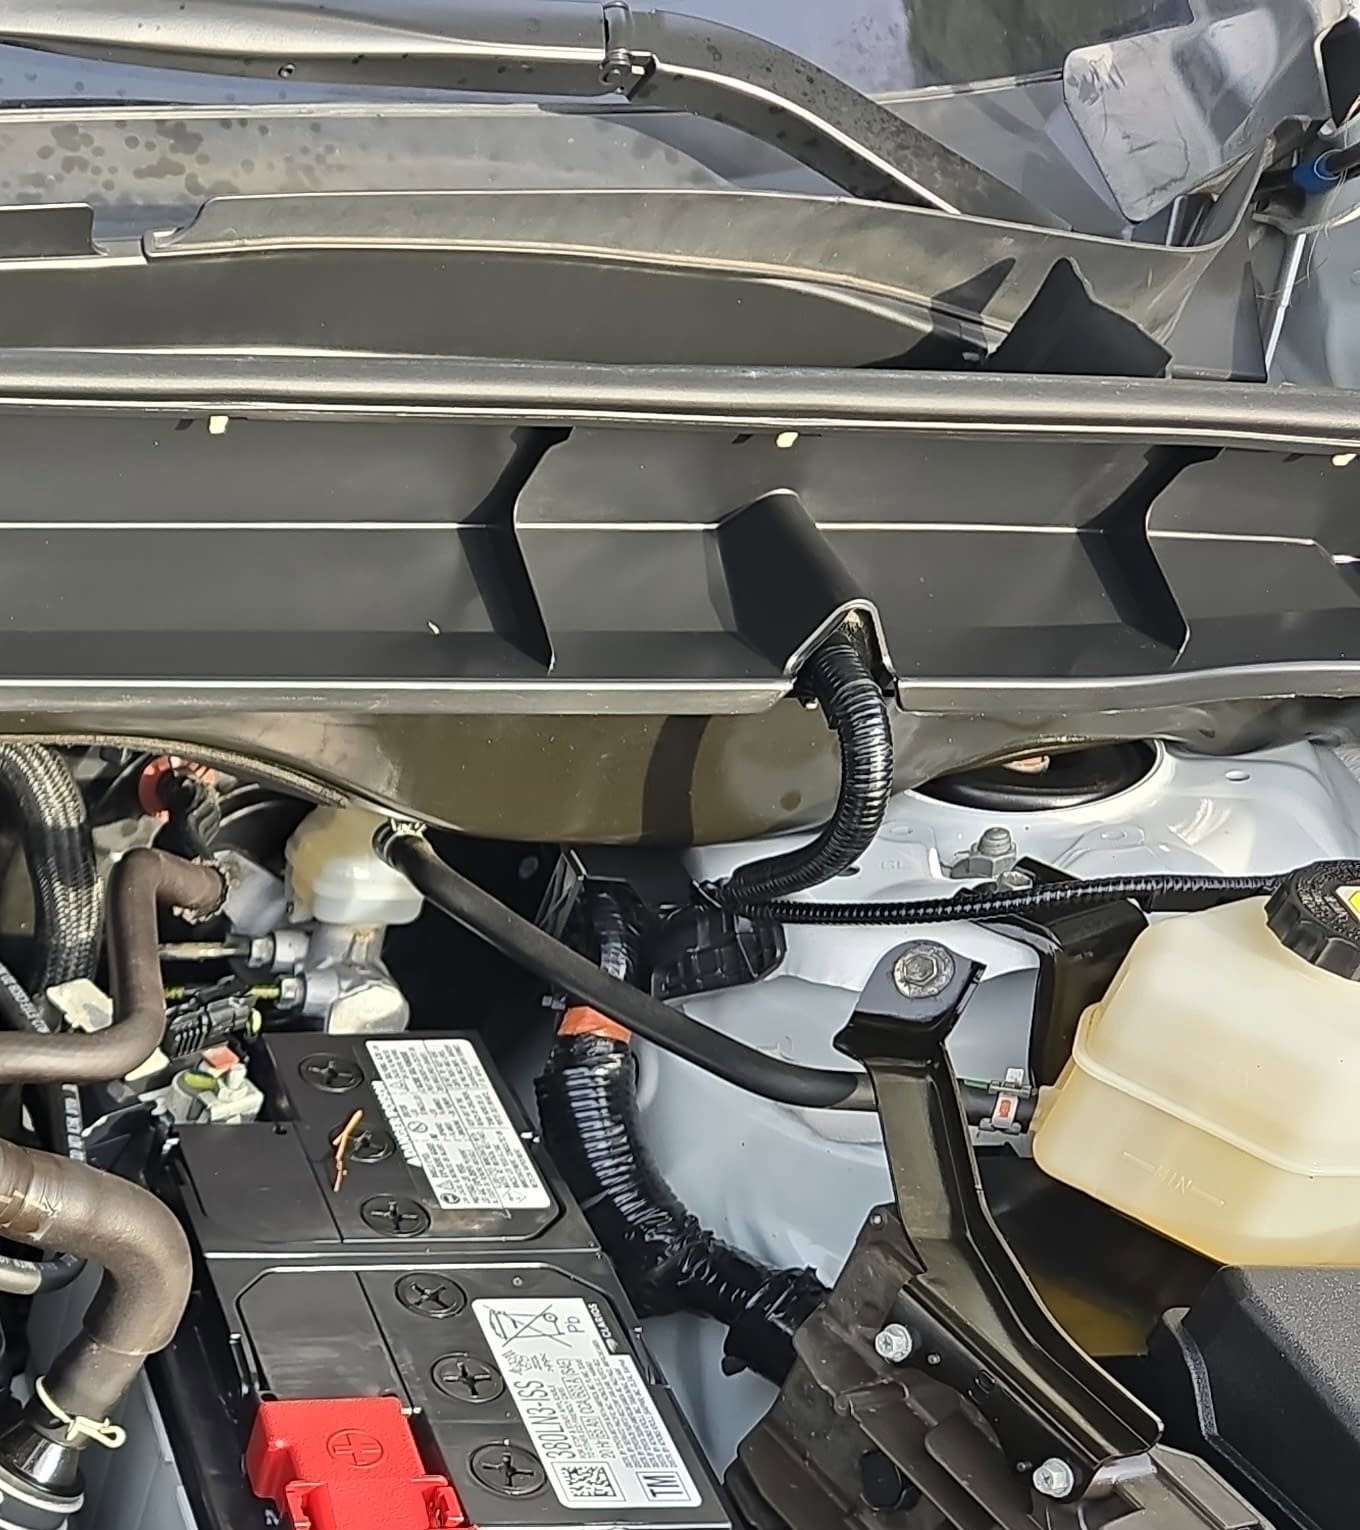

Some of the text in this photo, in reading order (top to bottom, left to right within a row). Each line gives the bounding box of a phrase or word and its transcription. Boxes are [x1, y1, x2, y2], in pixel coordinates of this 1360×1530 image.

[565, 1316, 584, 1333] Pb
[588, 1303, 611, 1338] CLARIOS
[513, 1380, 577, 1459] 380LN3-ISS
[642, 1475, 683, 1498] TM
